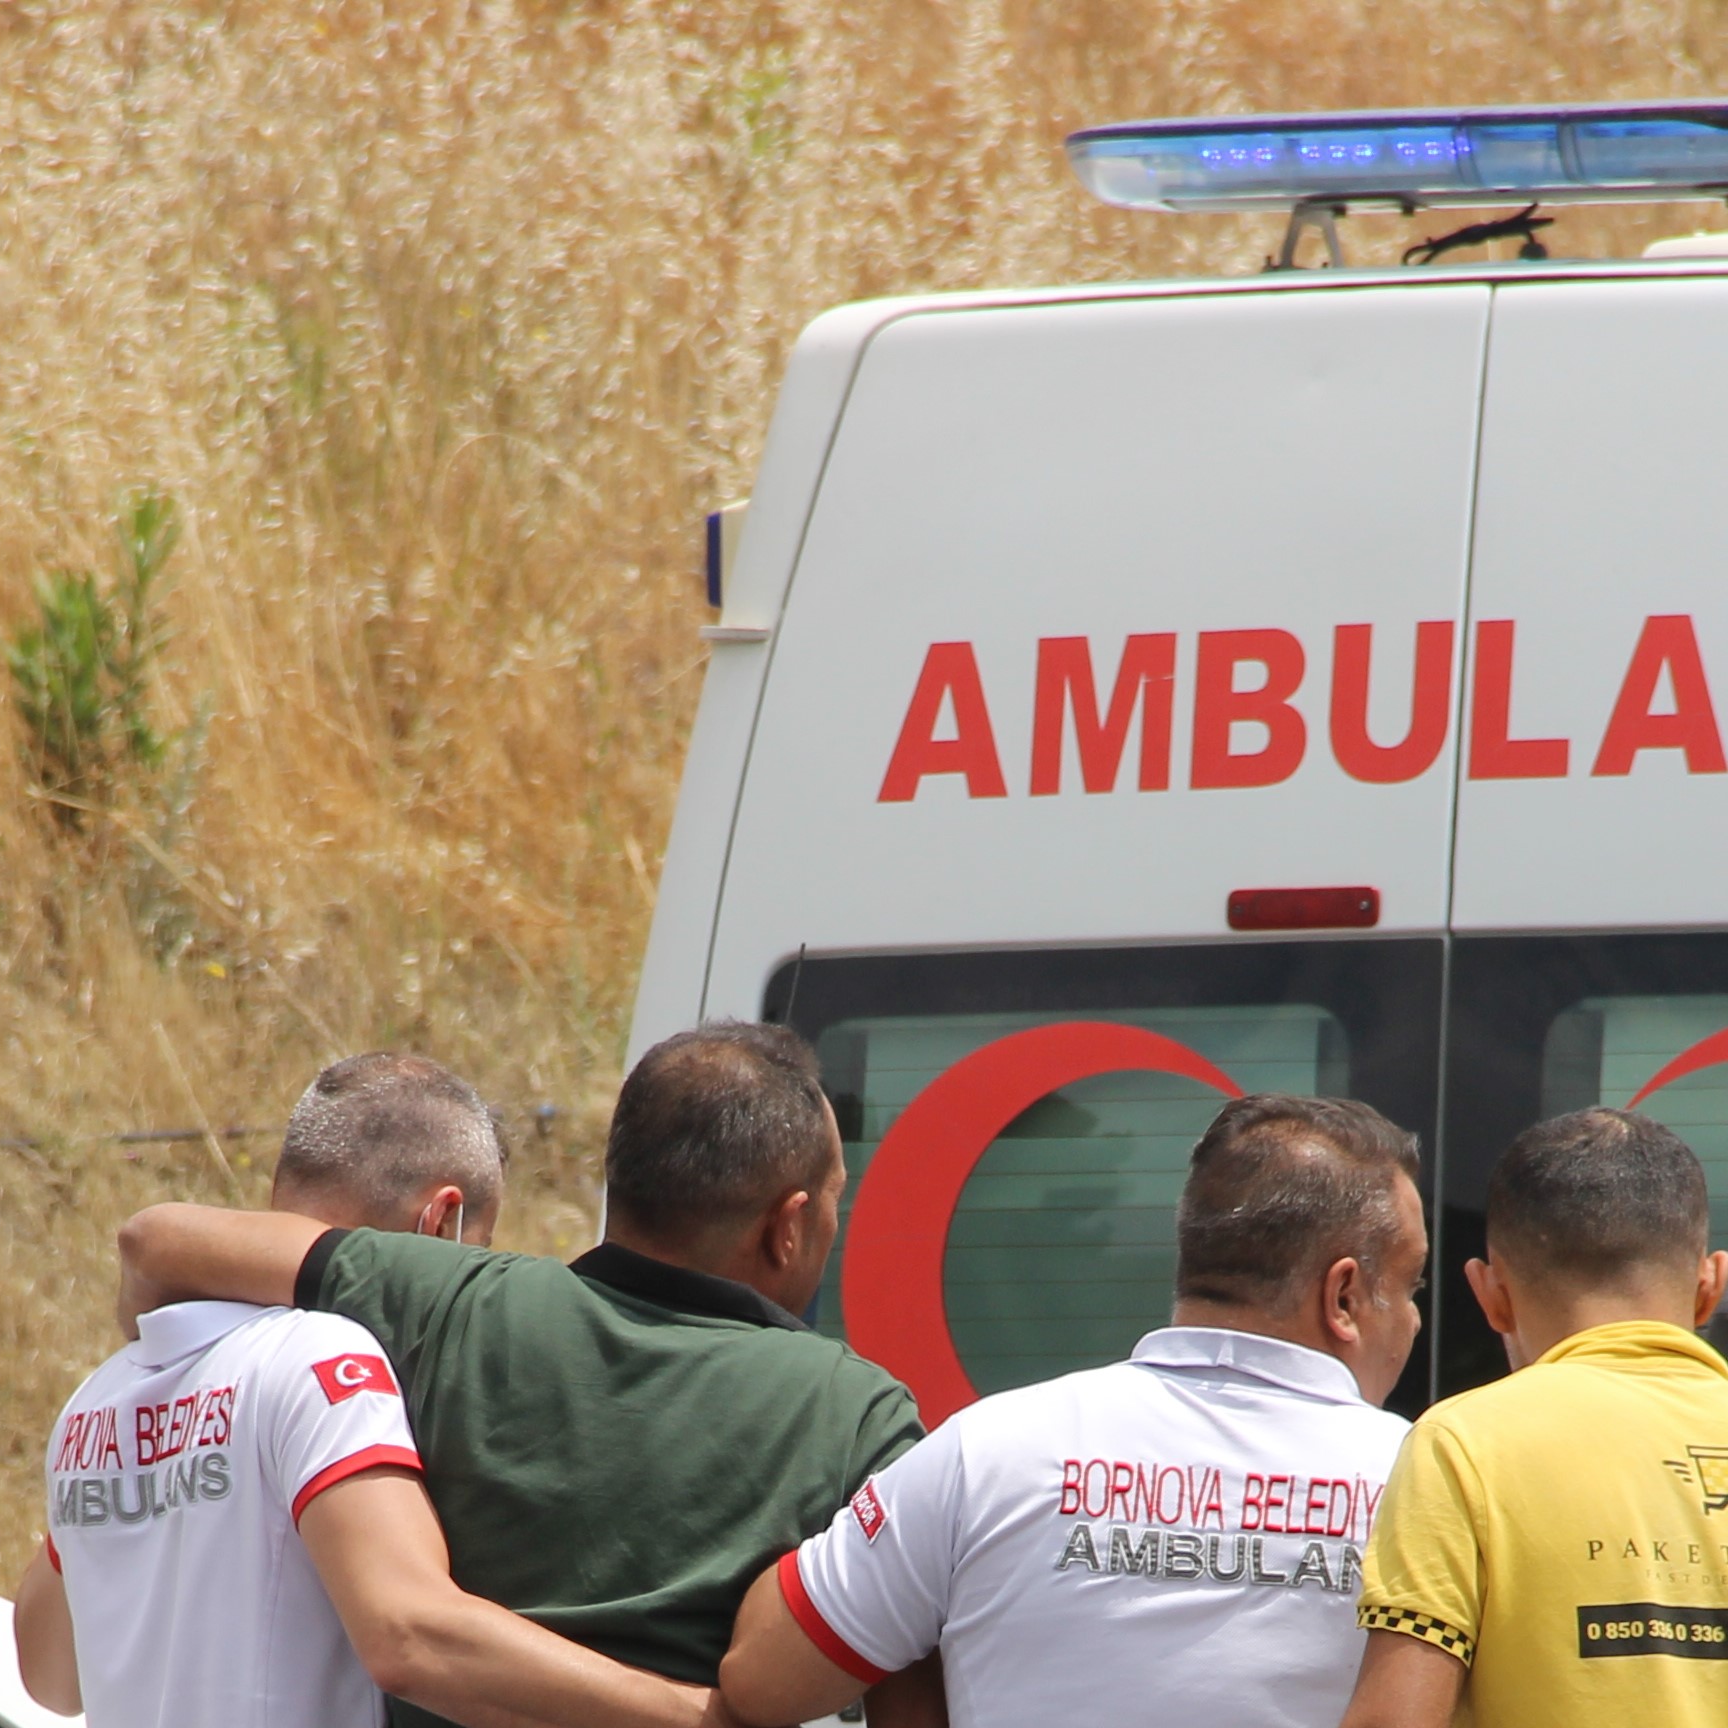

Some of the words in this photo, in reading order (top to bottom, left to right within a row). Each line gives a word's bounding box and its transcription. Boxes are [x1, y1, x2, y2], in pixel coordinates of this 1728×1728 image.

[1058, 1459, 1225, 1531] BORNOVA
[1586, 1621, 1601, 1640] 0
[1604, 1620, 1645, 1639] 850
[1674, 1622, 1687, 1642] 0
[1690, 1623, 1726, 1643] 336
